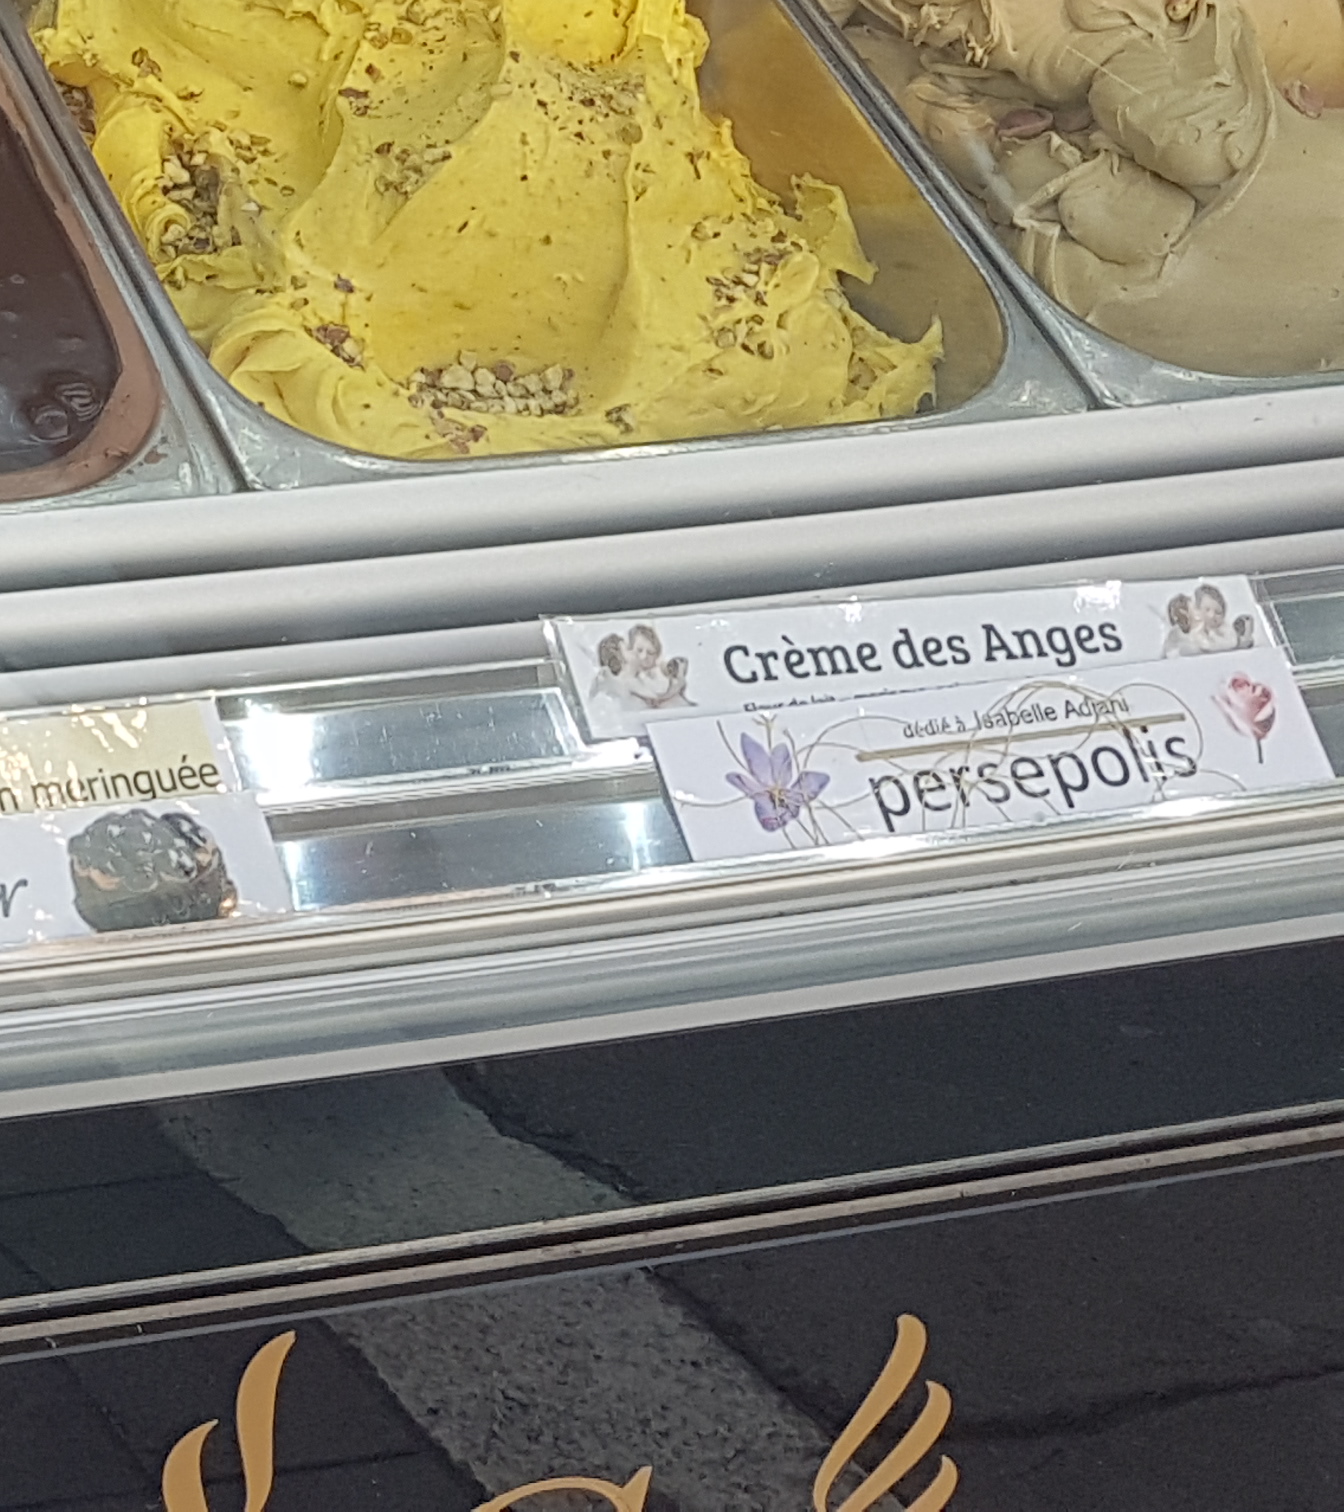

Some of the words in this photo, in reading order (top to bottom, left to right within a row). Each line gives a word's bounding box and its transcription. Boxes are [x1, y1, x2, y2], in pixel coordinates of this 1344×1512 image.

[722, 635, 882, 686] Crème
[894, 628, 971, 669] des
[984, 617, 1124, 671] Anges
[973, 702, 1059, 731] Isabelle
[31, 754, 221, 807] meringuée
[869, 724, 1199, 834] persepolis
